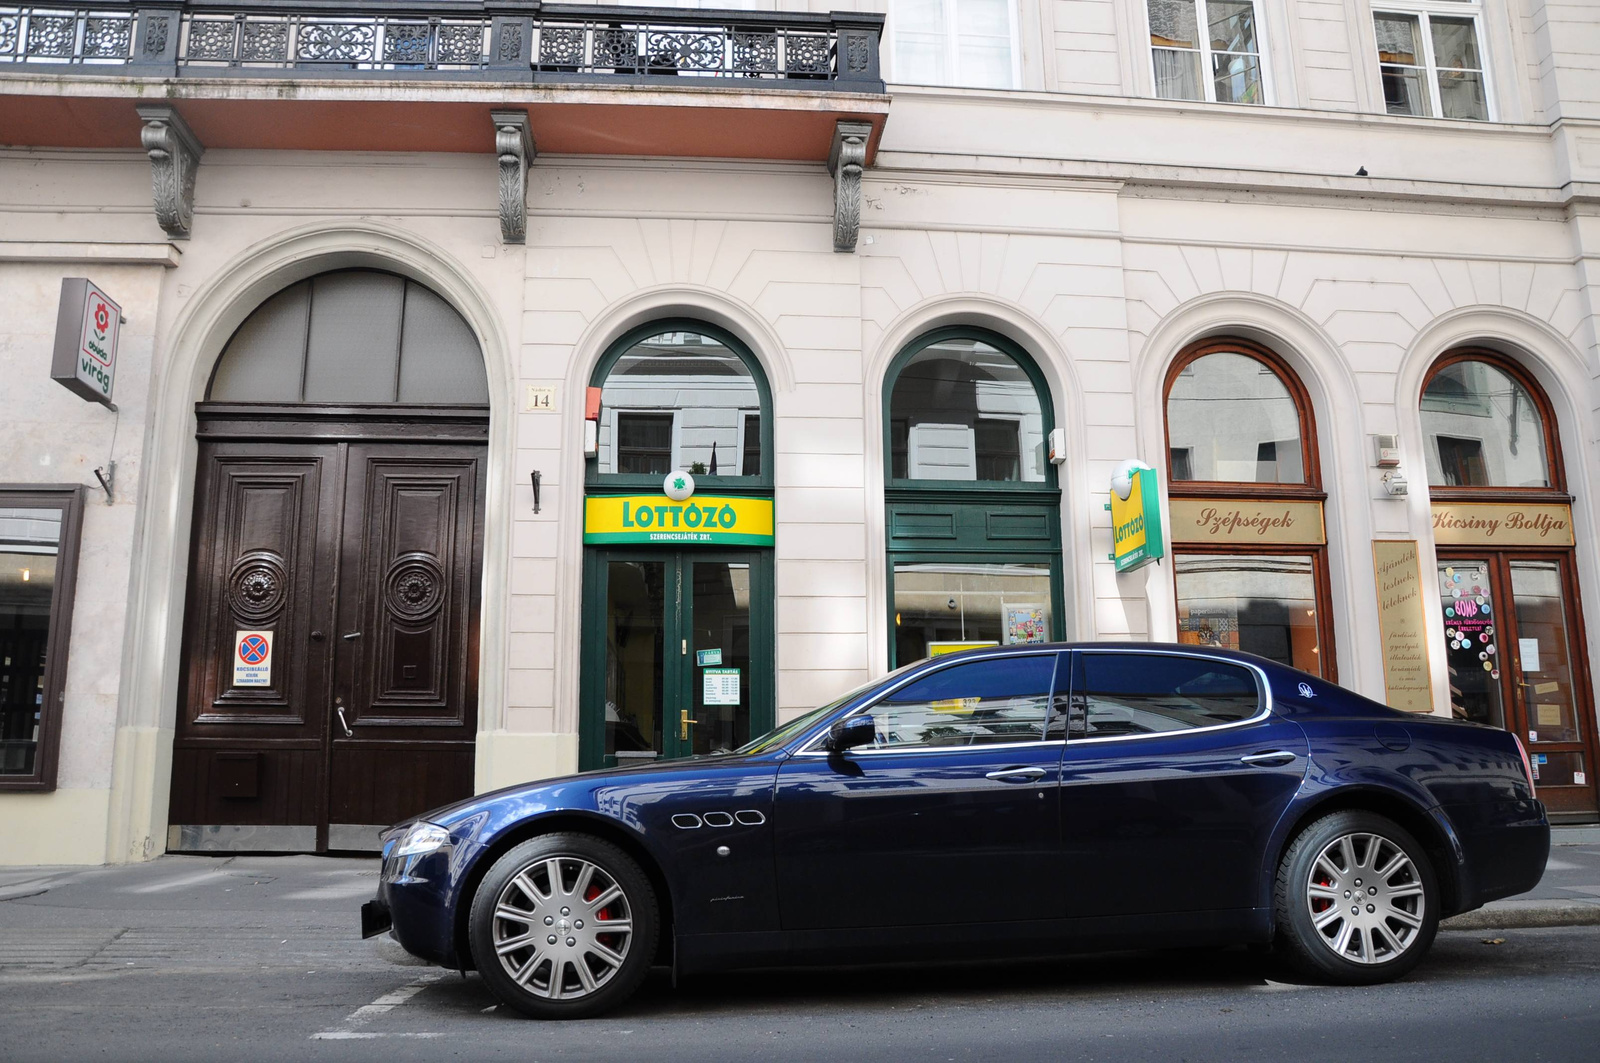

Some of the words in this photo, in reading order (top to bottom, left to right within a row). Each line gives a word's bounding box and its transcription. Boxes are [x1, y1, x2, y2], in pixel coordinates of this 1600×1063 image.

[82, 358, 110, 394] virág
[534, 394, 550, 407] 14
[622, 501, 737, 529] LOTTÓZÓ
[1114, 512, 1144, 544] LOTTÓZÓ
[1196, 507, 1295, 535] Szépségek
[1431, 510, 1503, 537] Kicsiny
[1504, 510, 1568, 538] Boltja
[649, 531, 698, 541] SZERENCSEJÁTÉK
[699, 533, 713, 541] ZRT.
[1377, 550, 1415, 576] Ajándék
[1382, 587, 1417, 611] léleknek
[1454, 600, 1478, 617] BOMB
[1389, 642, 1419, 652] gyertyák
